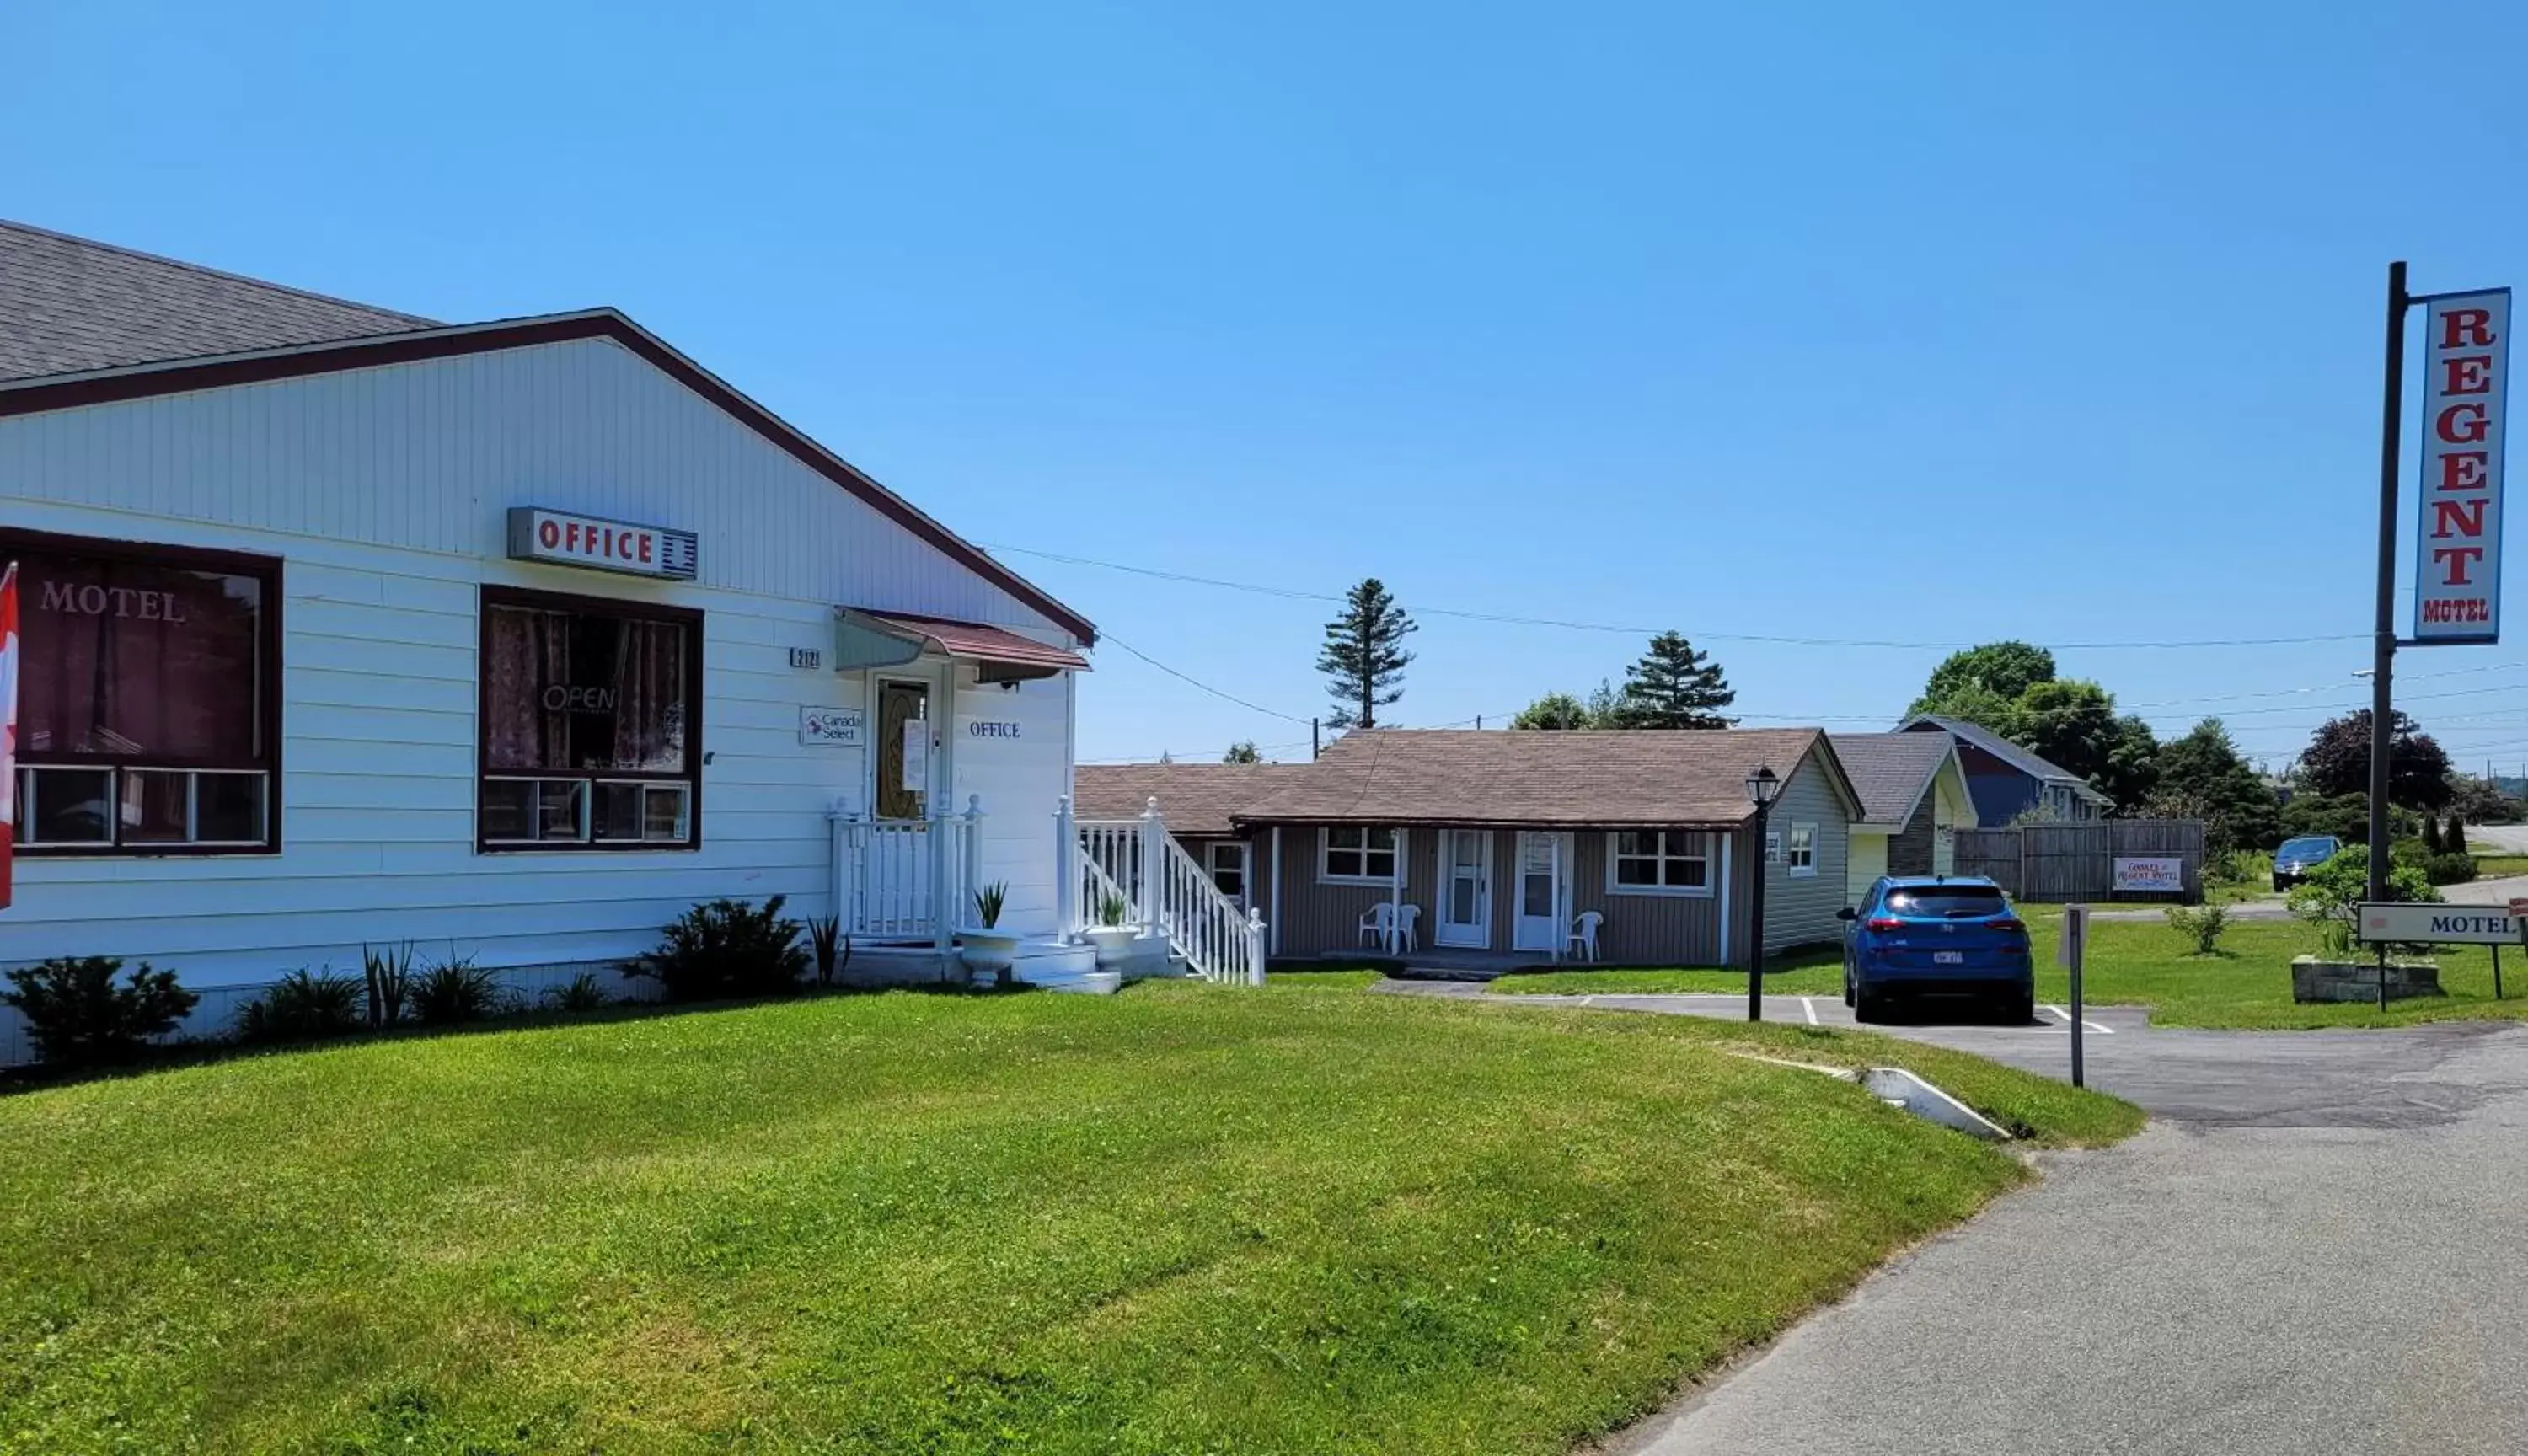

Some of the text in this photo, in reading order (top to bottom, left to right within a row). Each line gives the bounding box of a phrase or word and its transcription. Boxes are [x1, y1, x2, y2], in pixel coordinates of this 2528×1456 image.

[2430, 309, 2496, 585] REGENT
[539, 520, 651, 563] OFFICE
[40, 581, 186, 623] MOTEL
[2423, 598, 2488, 623] MOTEL
[543, 685, 616, 710] OPEN
[822, 714, 863, 728] Canada
[823, 727, 854, 740] Select
[971, 721, 1020, 738] OFFICE
[2429, 916, 2517, 934] MOTEL
